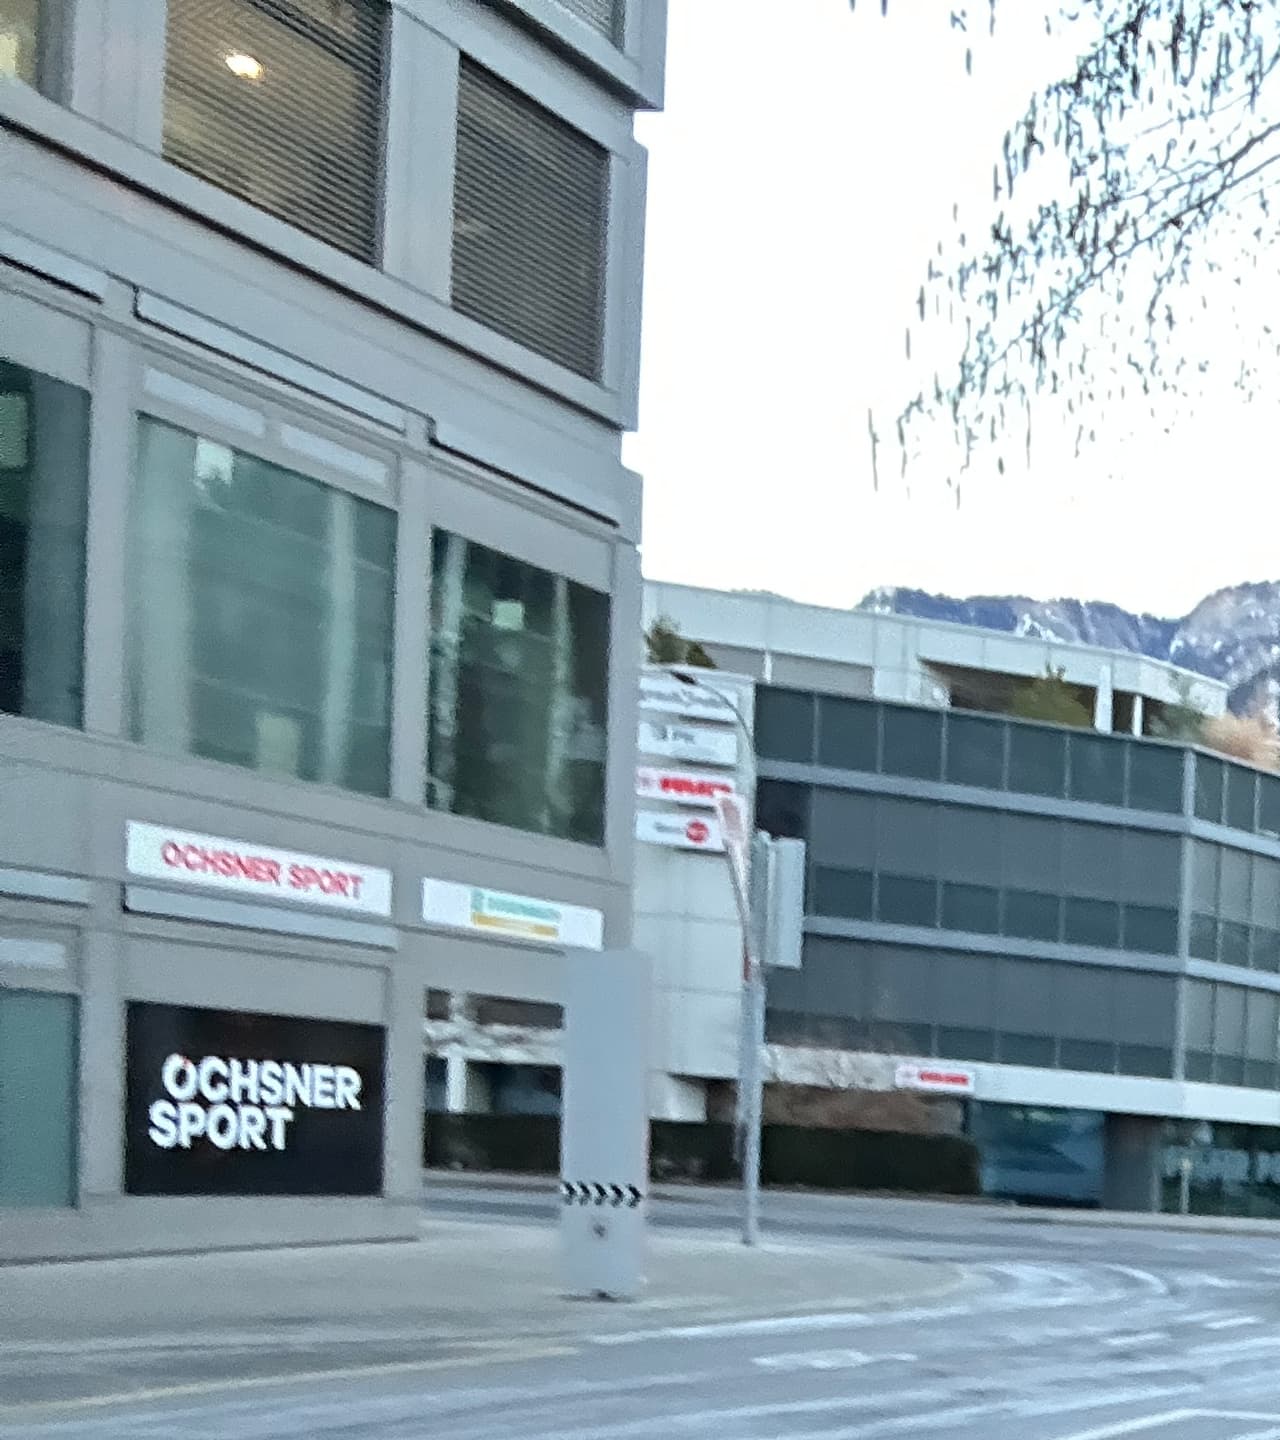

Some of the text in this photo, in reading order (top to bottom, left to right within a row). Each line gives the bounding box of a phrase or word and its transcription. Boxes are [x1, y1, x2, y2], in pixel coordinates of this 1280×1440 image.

[161, 841, 363, 900] OCHSNER SPORT
[162, 1053, 362, 1110] OCHSNER
[148, 1099, 295, 1150] SPORT
